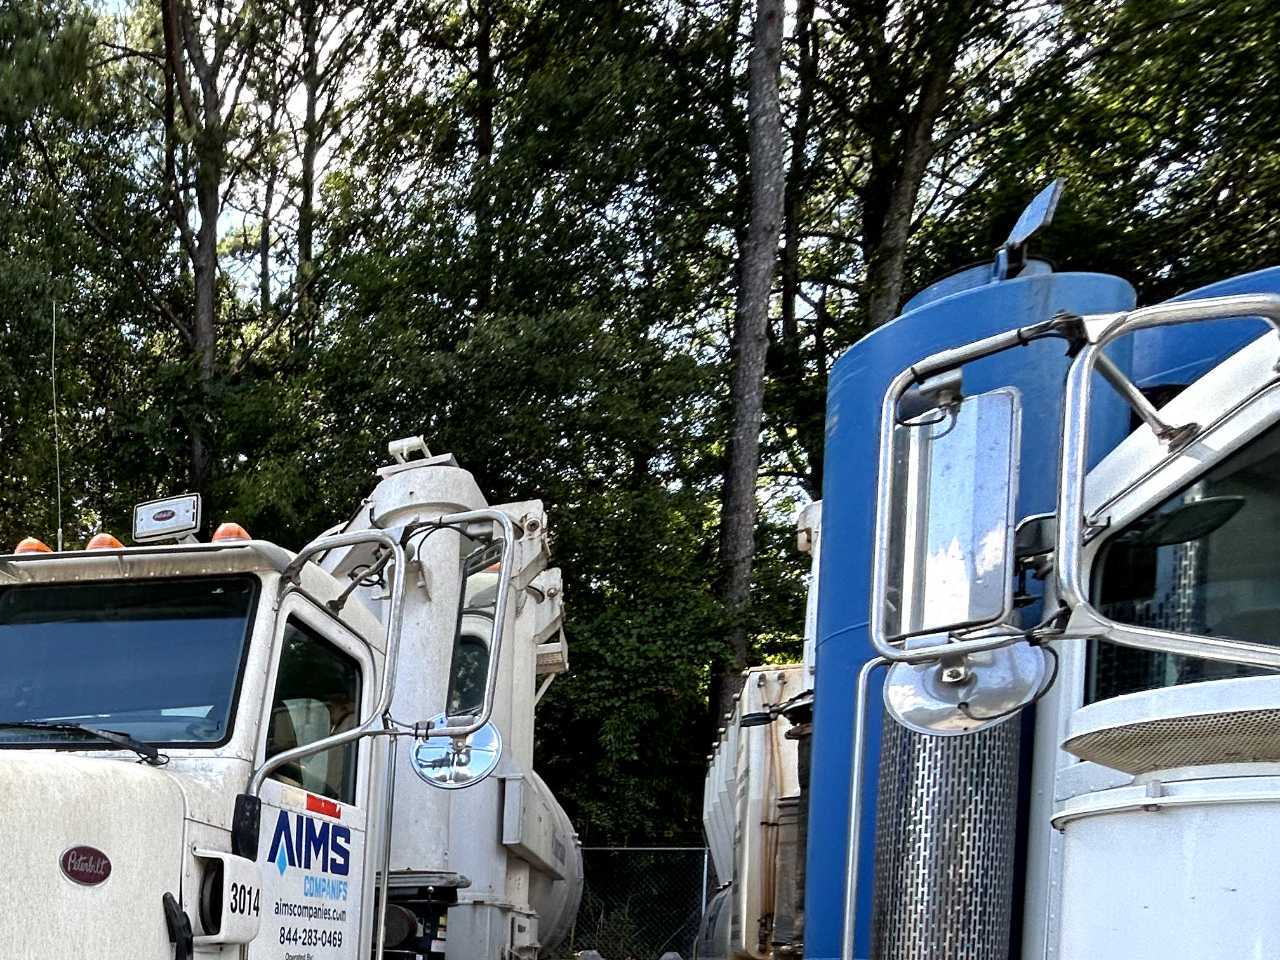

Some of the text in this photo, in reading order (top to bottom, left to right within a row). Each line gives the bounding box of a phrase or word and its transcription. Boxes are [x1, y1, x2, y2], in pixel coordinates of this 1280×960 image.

[267, 810, 350, 876] AIMS
[230, 882, 260, 917] 3014
[274, 898, 346, 921] aimscompanies.com
[279, 926, 343, 948] 844-283-0469
